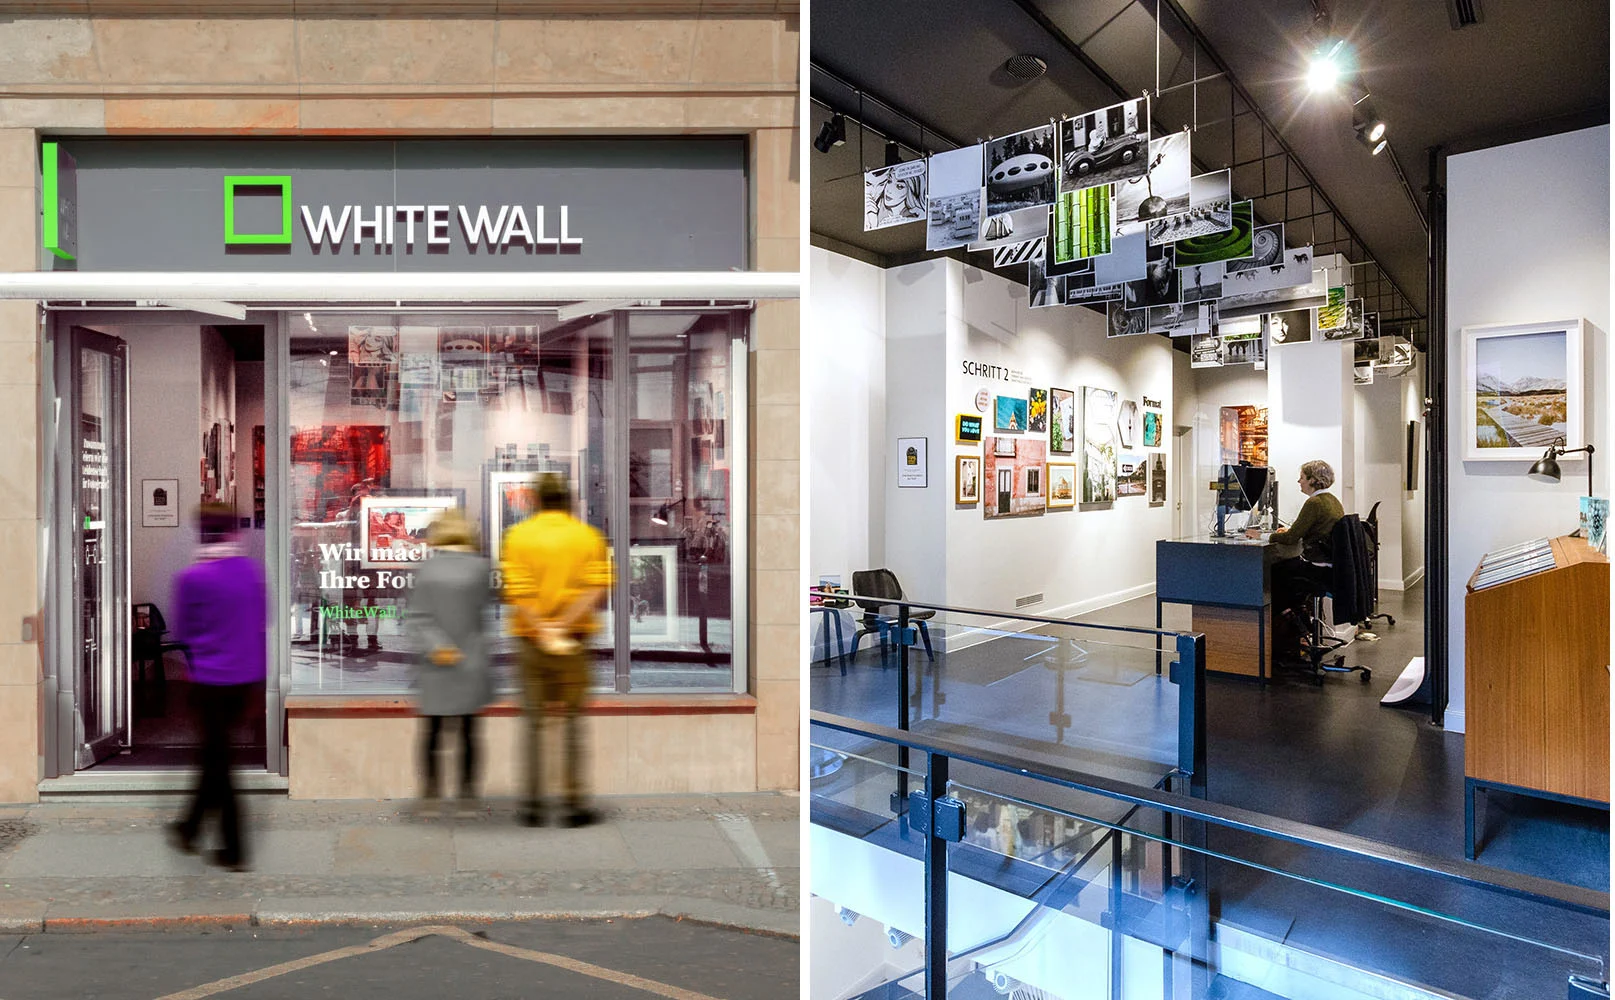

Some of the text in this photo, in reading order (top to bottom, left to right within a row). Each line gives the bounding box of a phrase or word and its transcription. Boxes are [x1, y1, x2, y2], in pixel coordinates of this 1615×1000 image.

[301, 205, 583, 245] WHITE WALL
[962, 360, 1002, 380] SCHRITT
[1003, 368, 1009, 381] 2
[318, 542, 434, 562] Wir mach
[319, 570, 416, 589] Ihre Fot
[319, 606, 408, 621] WhiteWall.c
